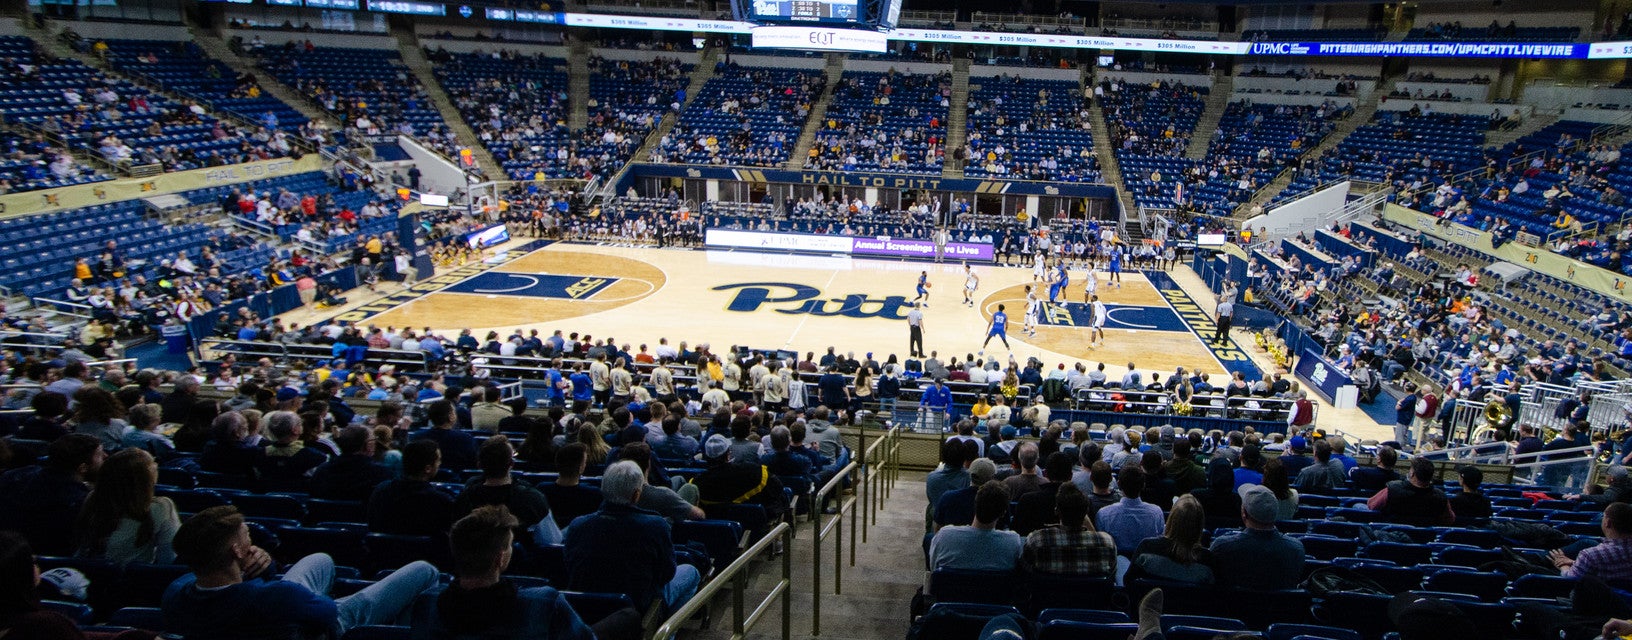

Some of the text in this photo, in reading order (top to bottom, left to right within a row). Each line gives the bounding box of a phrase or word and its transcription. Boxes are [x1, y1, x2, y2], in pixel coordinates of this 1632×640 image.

[1253, 43, 1290, 54] UPMC
[1319, 43, 1573, 56] PITTSBURGHPANTHERS.COM/UPMCPITTLIVEWIRE
[243, 165, 264, 177] TO
[802, 174, 941, 190] HAIL TO PITT
[1457, 228, 1480, 244] PITT
[855, 240, 885, 250] Annual
[886, 242, 933, 254] Screenings
[956, 245, 980, 255] Lives
[565, 277, 606, 299] ACC
[712, 282, 917, 320] Pitt
[995, 315, 1005, 324] 33
[1160, 289, 1249, 361] PANTHERS
